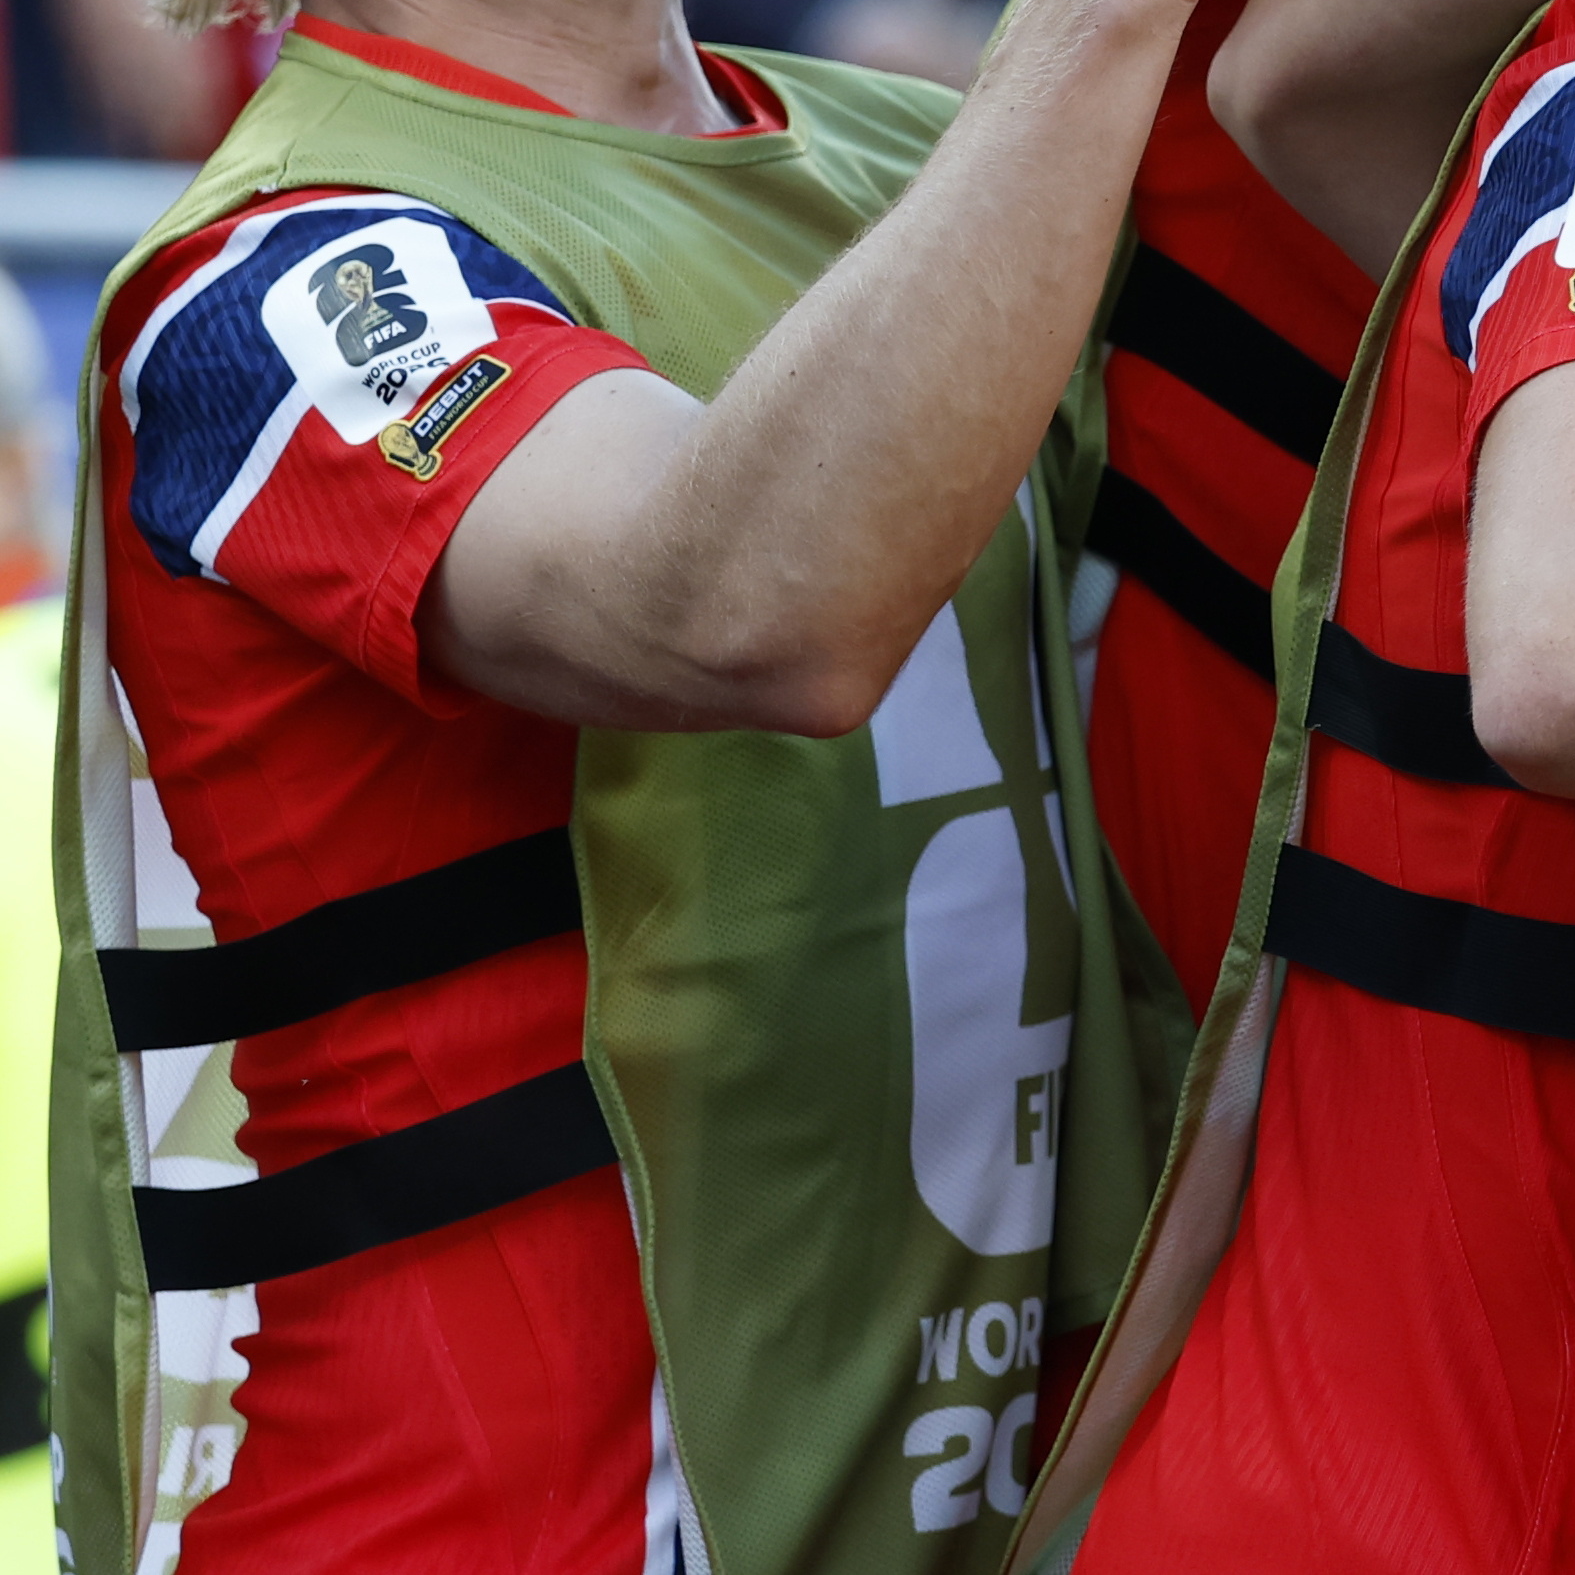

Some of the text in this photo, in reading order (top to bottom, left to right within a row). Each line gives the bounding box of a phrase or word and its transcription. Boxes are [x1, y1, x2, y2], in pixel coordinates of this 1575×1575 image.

[361, 342, 441, 389] WORLD CUP
[363, 320, 407, 350] FIFA
[413, 361, 483, 437] DEBUT
[445, 391, 475, 422] WORLD
[473, 375, 490, 394] CUP
[916, 1296, 1045, 1385] WOR
[902, 1391, 1038, 1533] 20
